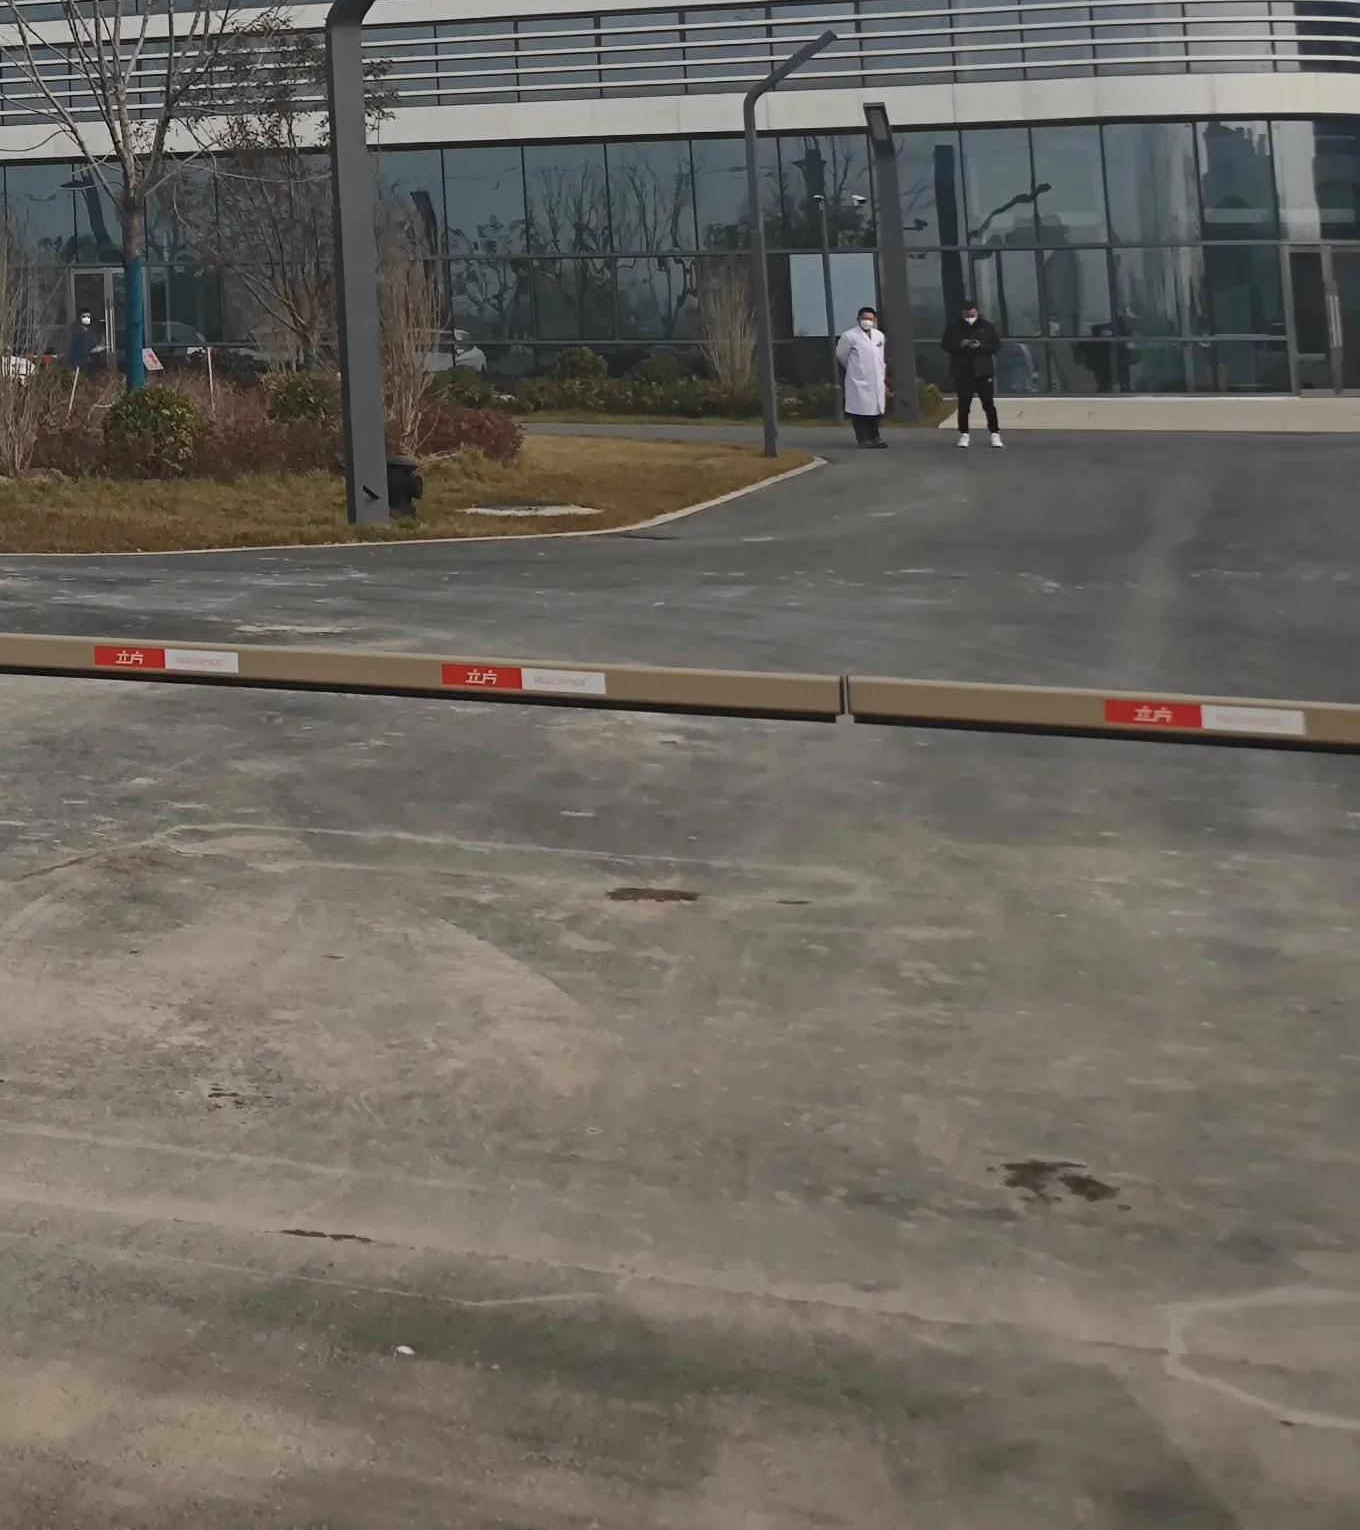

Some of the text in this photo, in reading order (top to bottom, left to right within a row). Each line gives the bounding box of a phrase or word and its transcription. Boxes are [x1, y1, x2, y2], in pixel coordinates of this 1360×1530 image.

[115, 650, 144, 665] 立方
[465, 668, 498, 685] 立方
[1133, 705, 1173, 723] 立方
